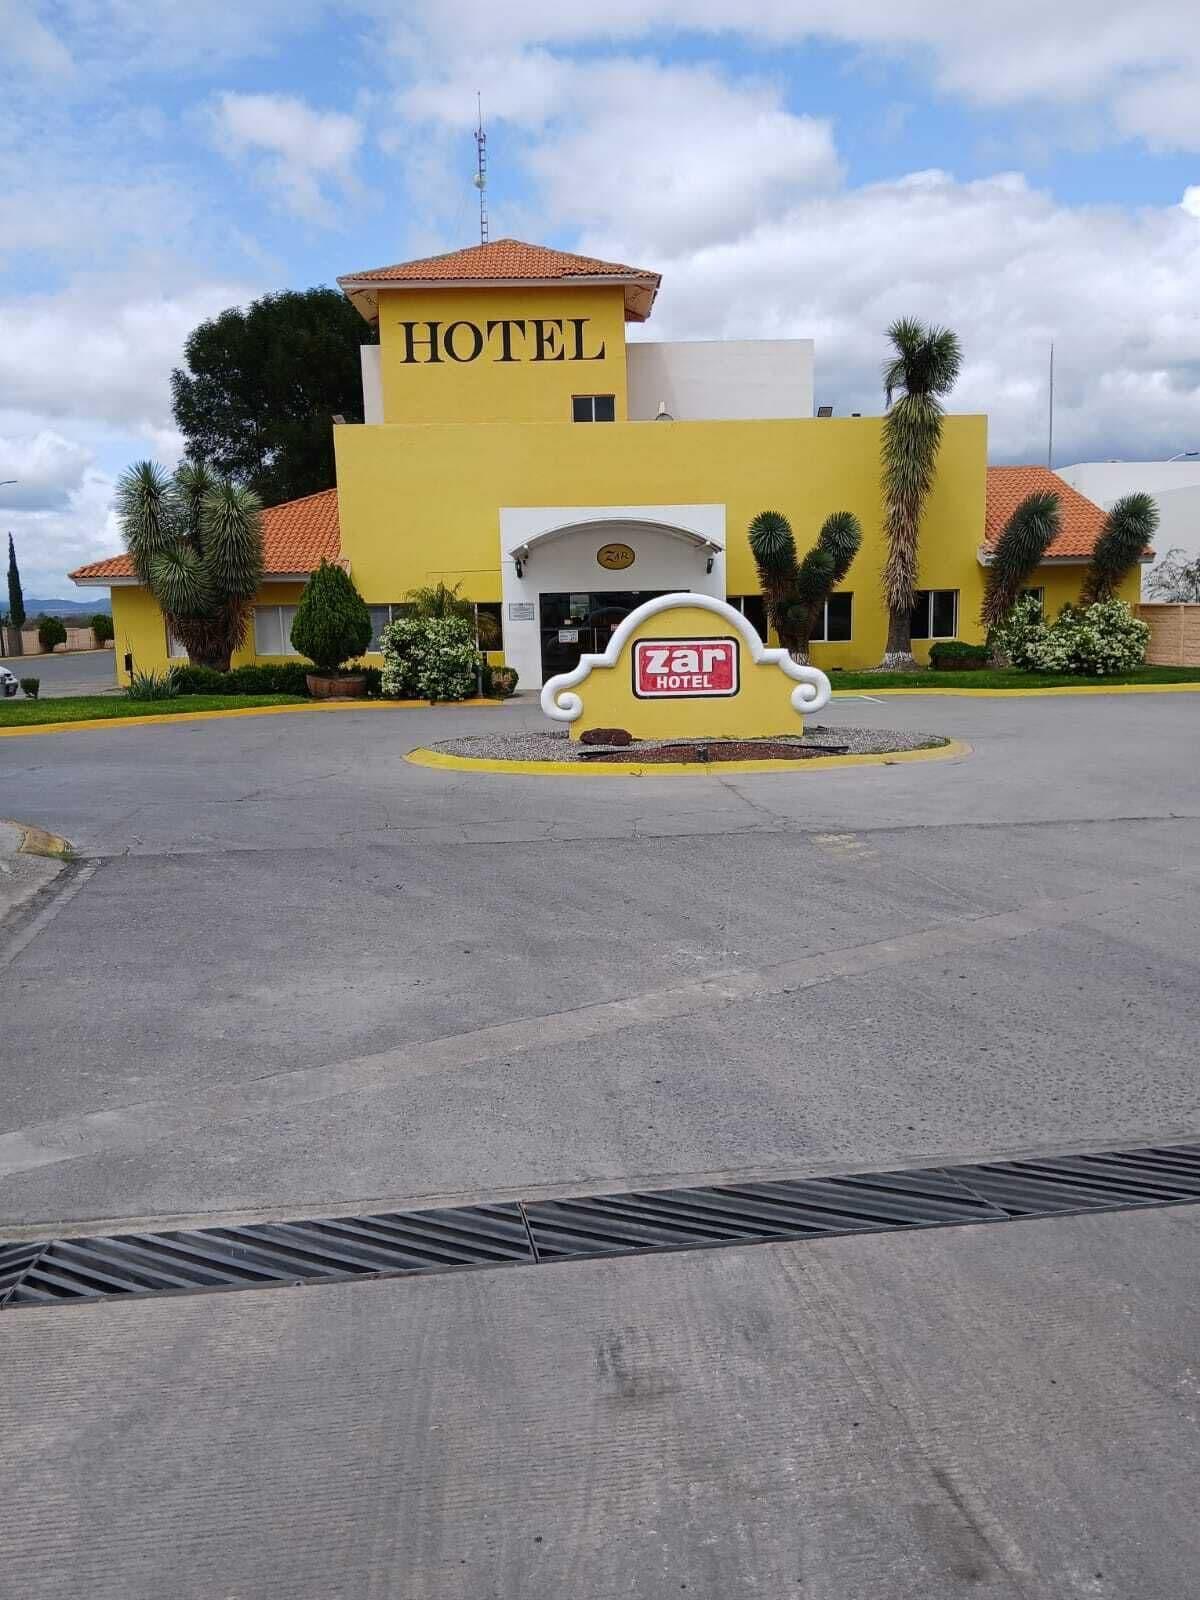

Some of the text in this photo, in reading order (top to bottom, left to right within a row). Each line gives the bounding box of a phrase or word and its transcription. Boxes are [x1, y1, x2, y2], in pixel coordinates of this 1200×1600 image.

[398, 318, 606, 364] HOTEL
[645, 648, 726, 674] zar
[656, 674, 713, 689] HOTEL
